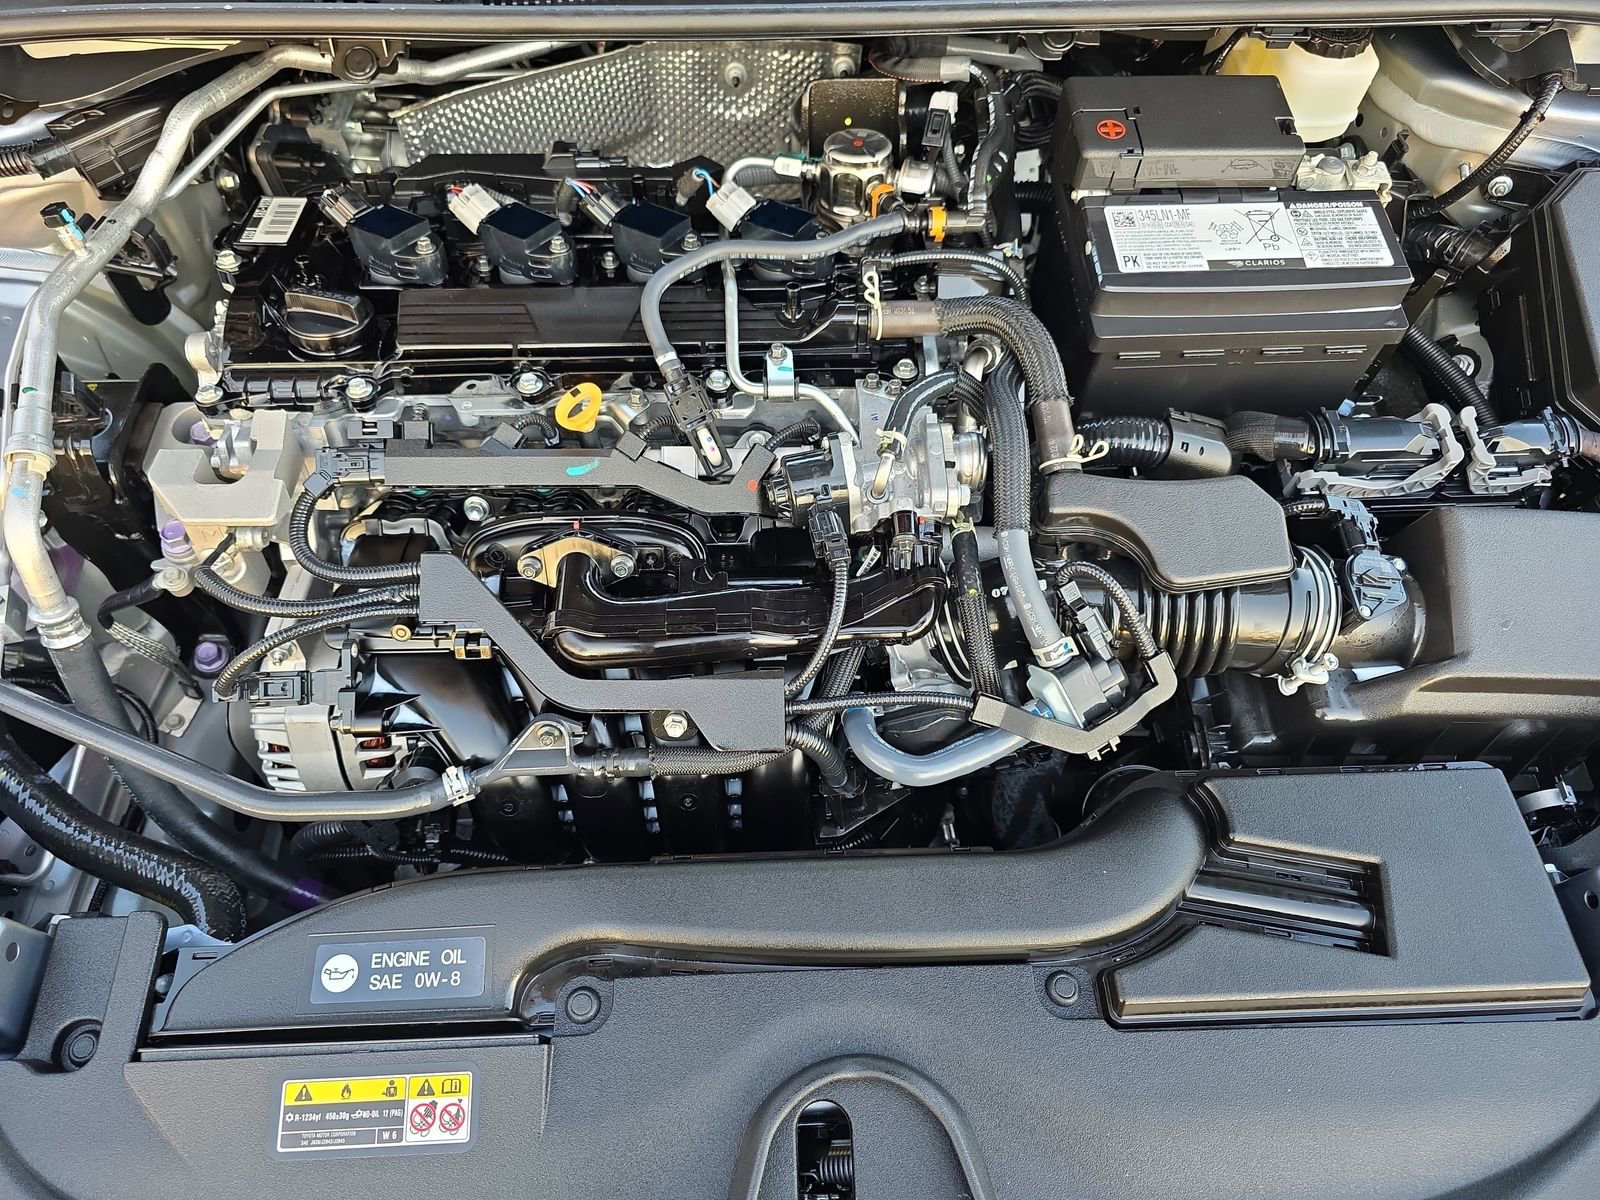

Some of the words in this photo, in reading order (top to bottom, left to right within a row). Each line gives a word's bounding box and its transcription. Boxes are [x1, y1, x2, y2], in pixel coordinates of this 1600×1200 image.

[1138, 208, 1191, 222] 345LN1-MF
[1263, 242, 1280, 251] Pb
[1123, 255, 1140, 268] PK
[371, 950, 430, 969] ENGINE
[440, 948, 467, 965] OIL
[369, 973, 403, 991] SAE
[415, 971, 461, 988] 0W-8
[295, 1112, 321, 1122] R-1234yf
[382, 1109, 389, 1118] 12
[382, 1131, 390, 1141] W
[392, 1130, 398, 1140] 6
